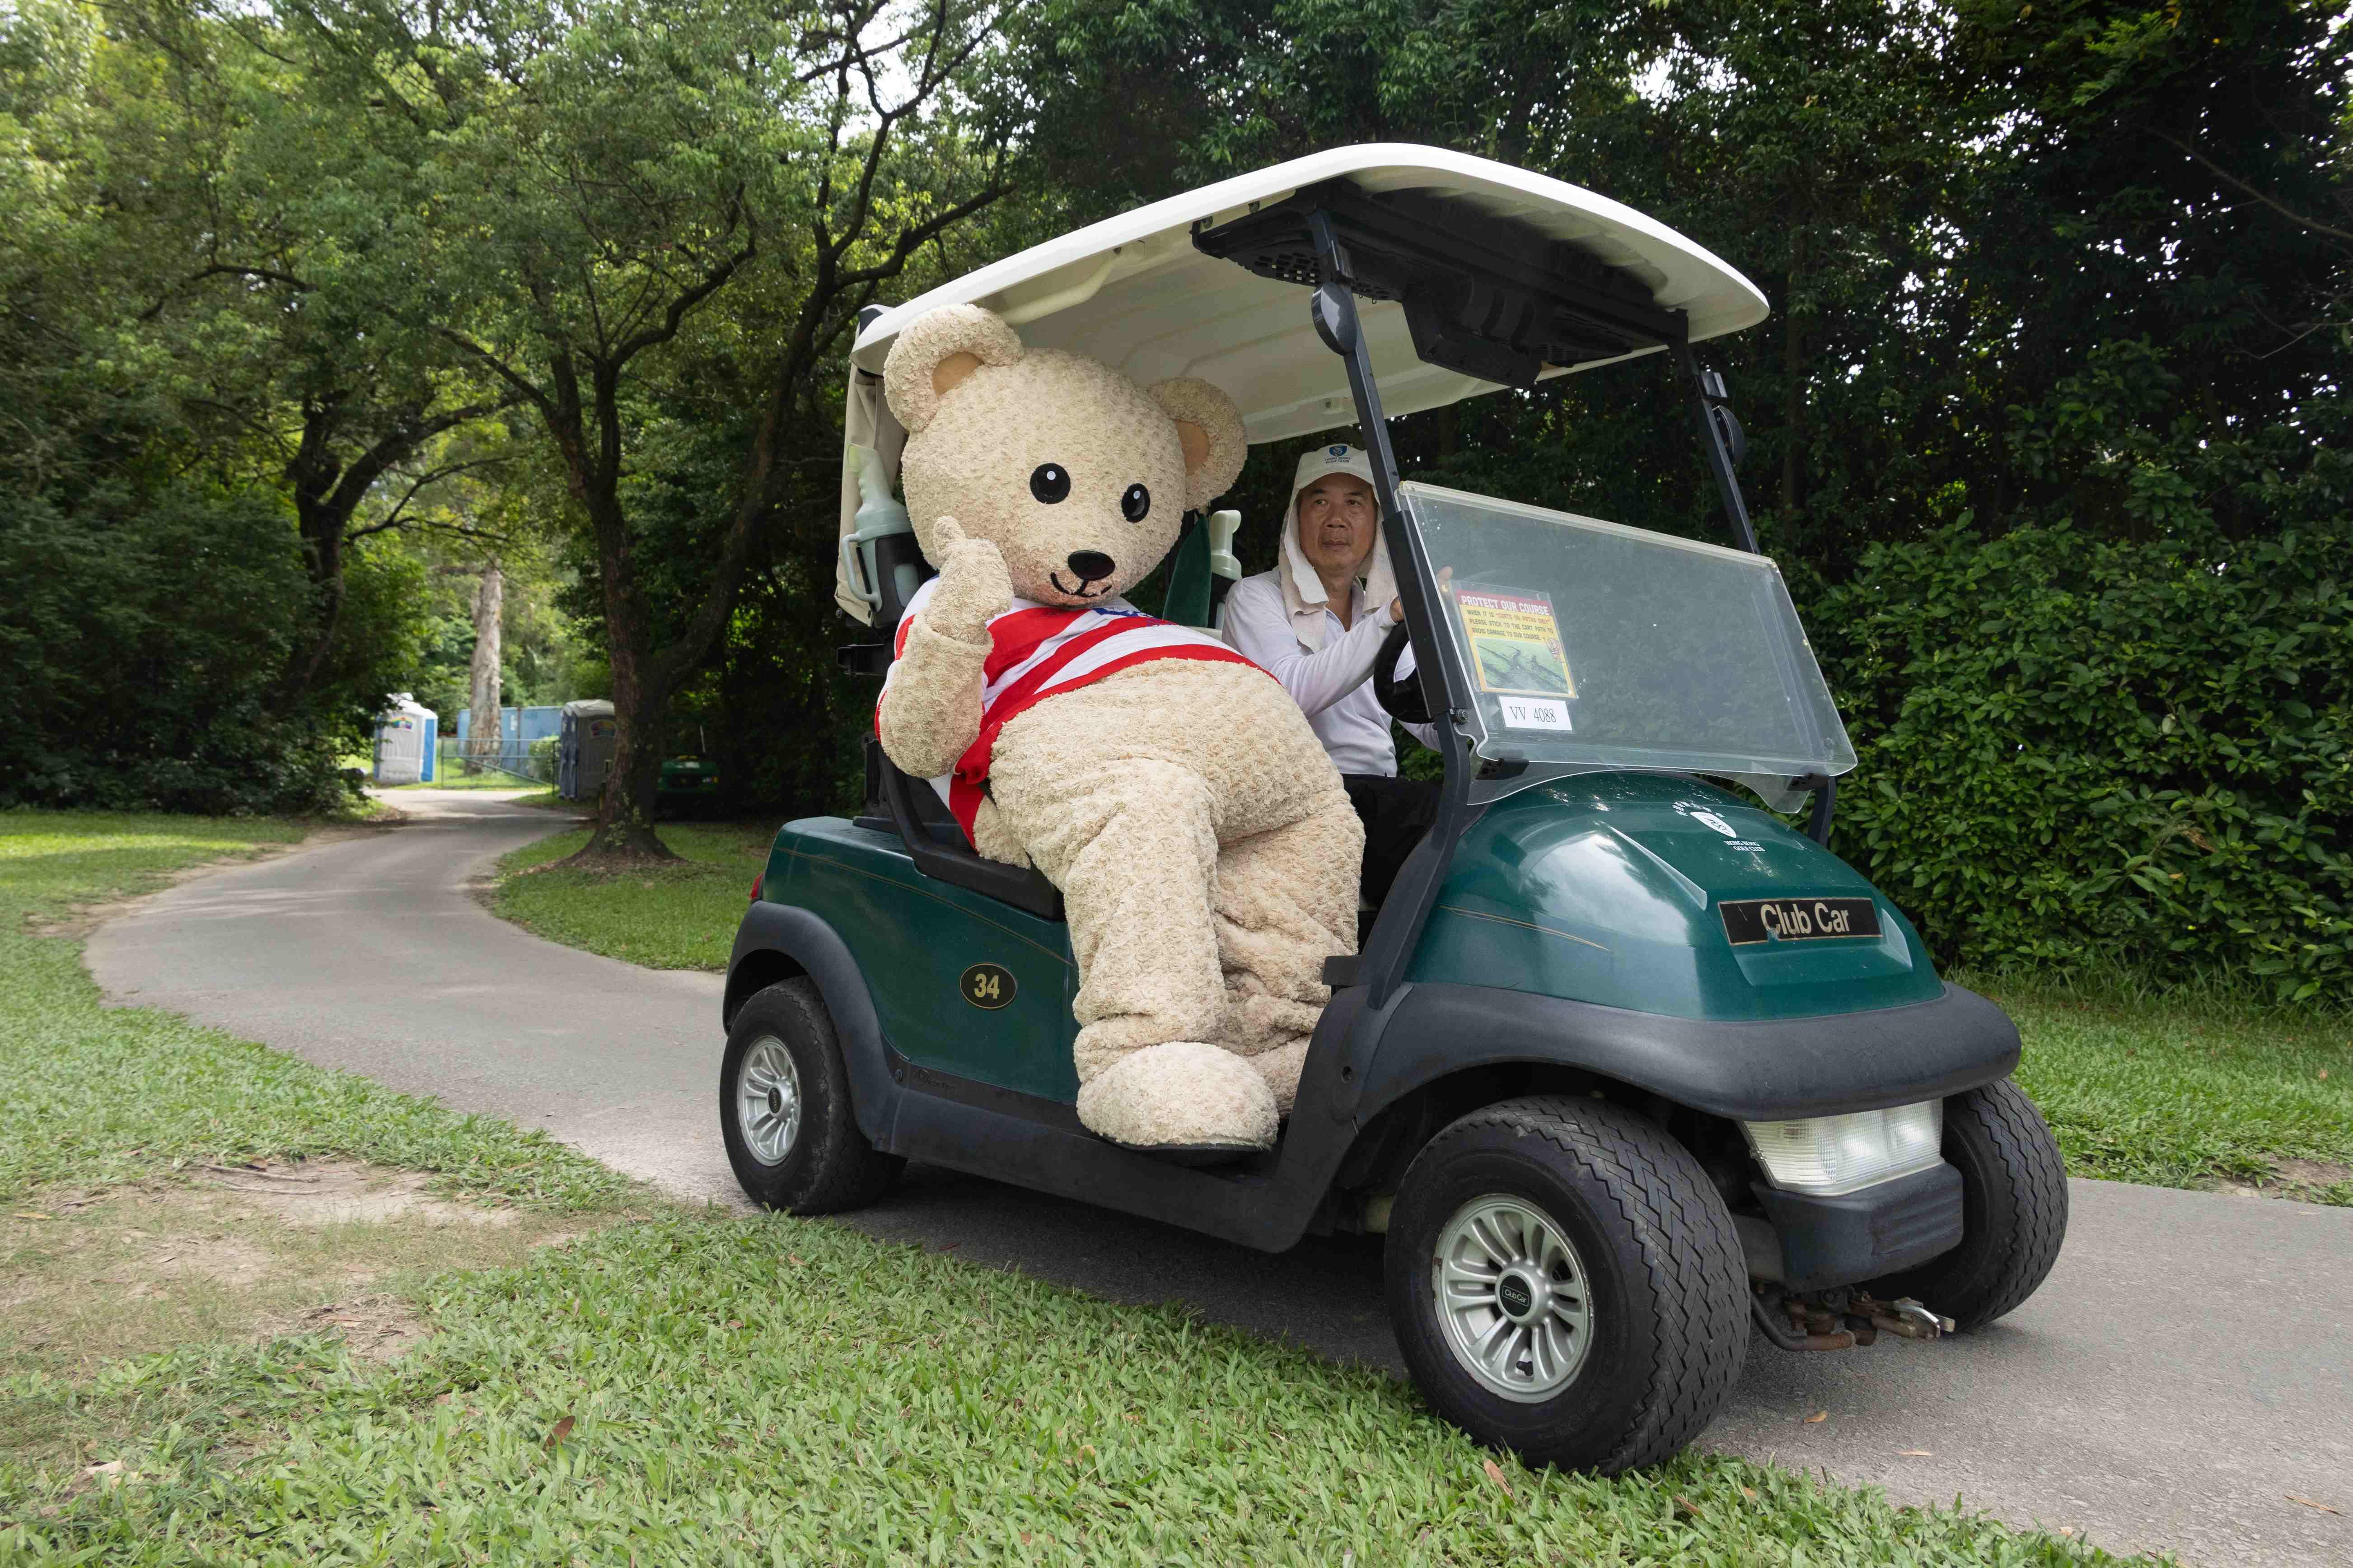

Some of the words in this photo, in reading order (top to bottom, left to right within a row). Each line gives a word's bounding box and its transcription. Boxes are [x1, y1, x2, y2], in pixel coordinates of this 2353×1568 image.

[1461, 595, 1498, 609] PROTECT
[1501, 600, 1517, 611] OUR
[1519, 603, 1549, 615] COURSE
[1534, 708, 1556, 723] 4088
[1760, 903, 1811, 934] Club
[1814, 902, 1850, 933] Car
[974, 973, 1000, 999] 34
[1505, 1289, 1517, 1299] Club
[1517, 1294, 1526, 1302] Car
